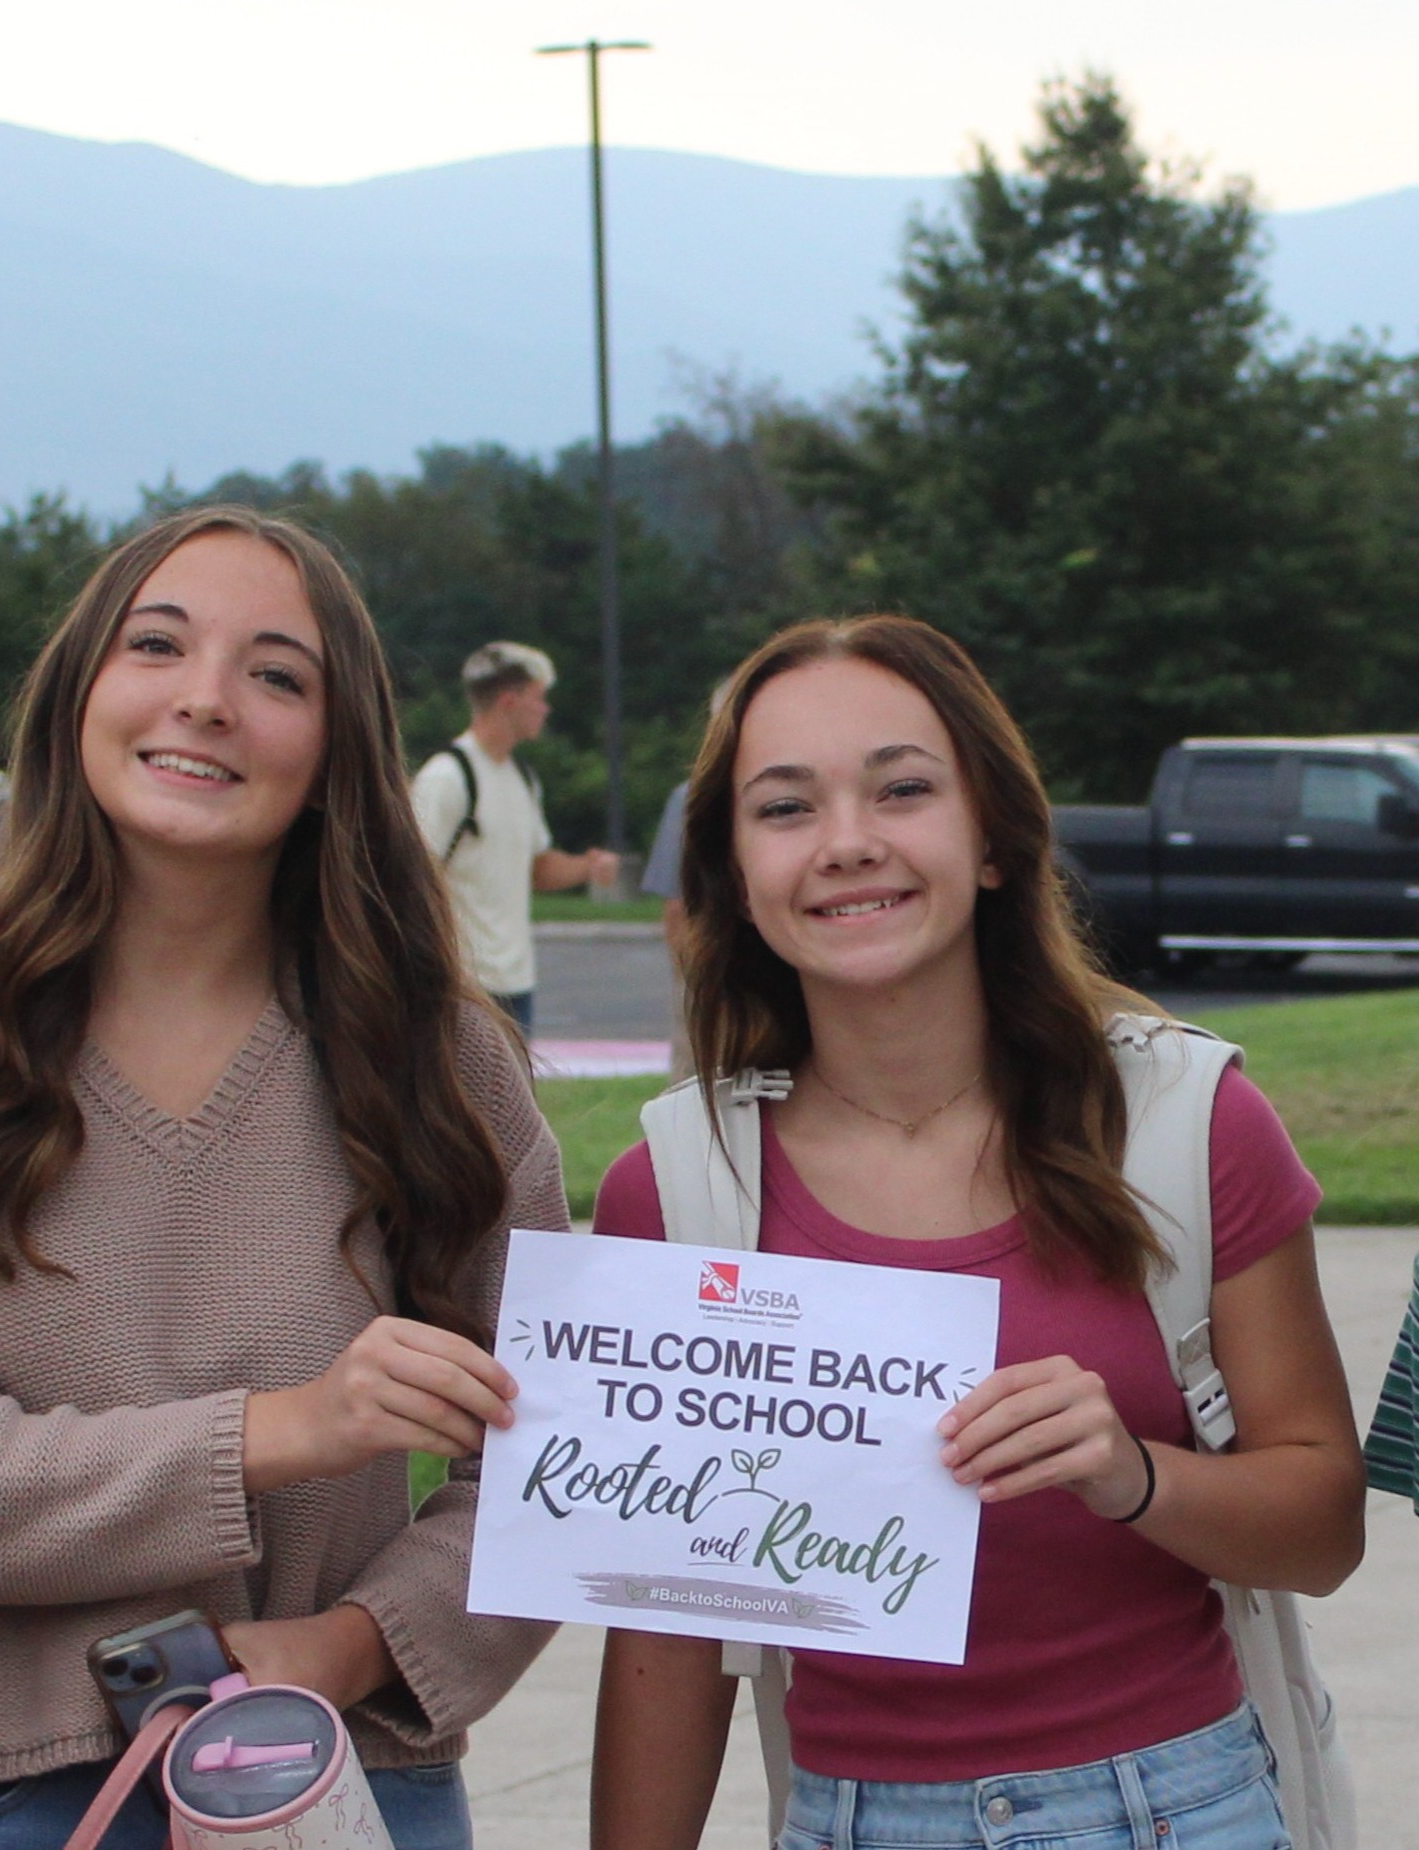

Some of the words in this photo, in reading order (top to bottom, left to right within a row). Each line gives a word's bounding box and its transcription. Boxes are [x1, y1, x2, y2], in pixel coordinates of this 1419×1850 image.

[741, 1288, 800, 1310] VSBA
[542, 1320, 796, 1384] WELCOME
[808, 1348, 949, 1400] BACK
[596, 1379, 664, 1422] TO
[675, 1387, 882, 1446] SCHOOL
[522, 1434, 722, 1524] Rooted
[689, 1527, 750, 1563] and
[752, 1499, 940, 1615] Ready
[649, 1587, 789, 1615] #BacktoSchoolVA
